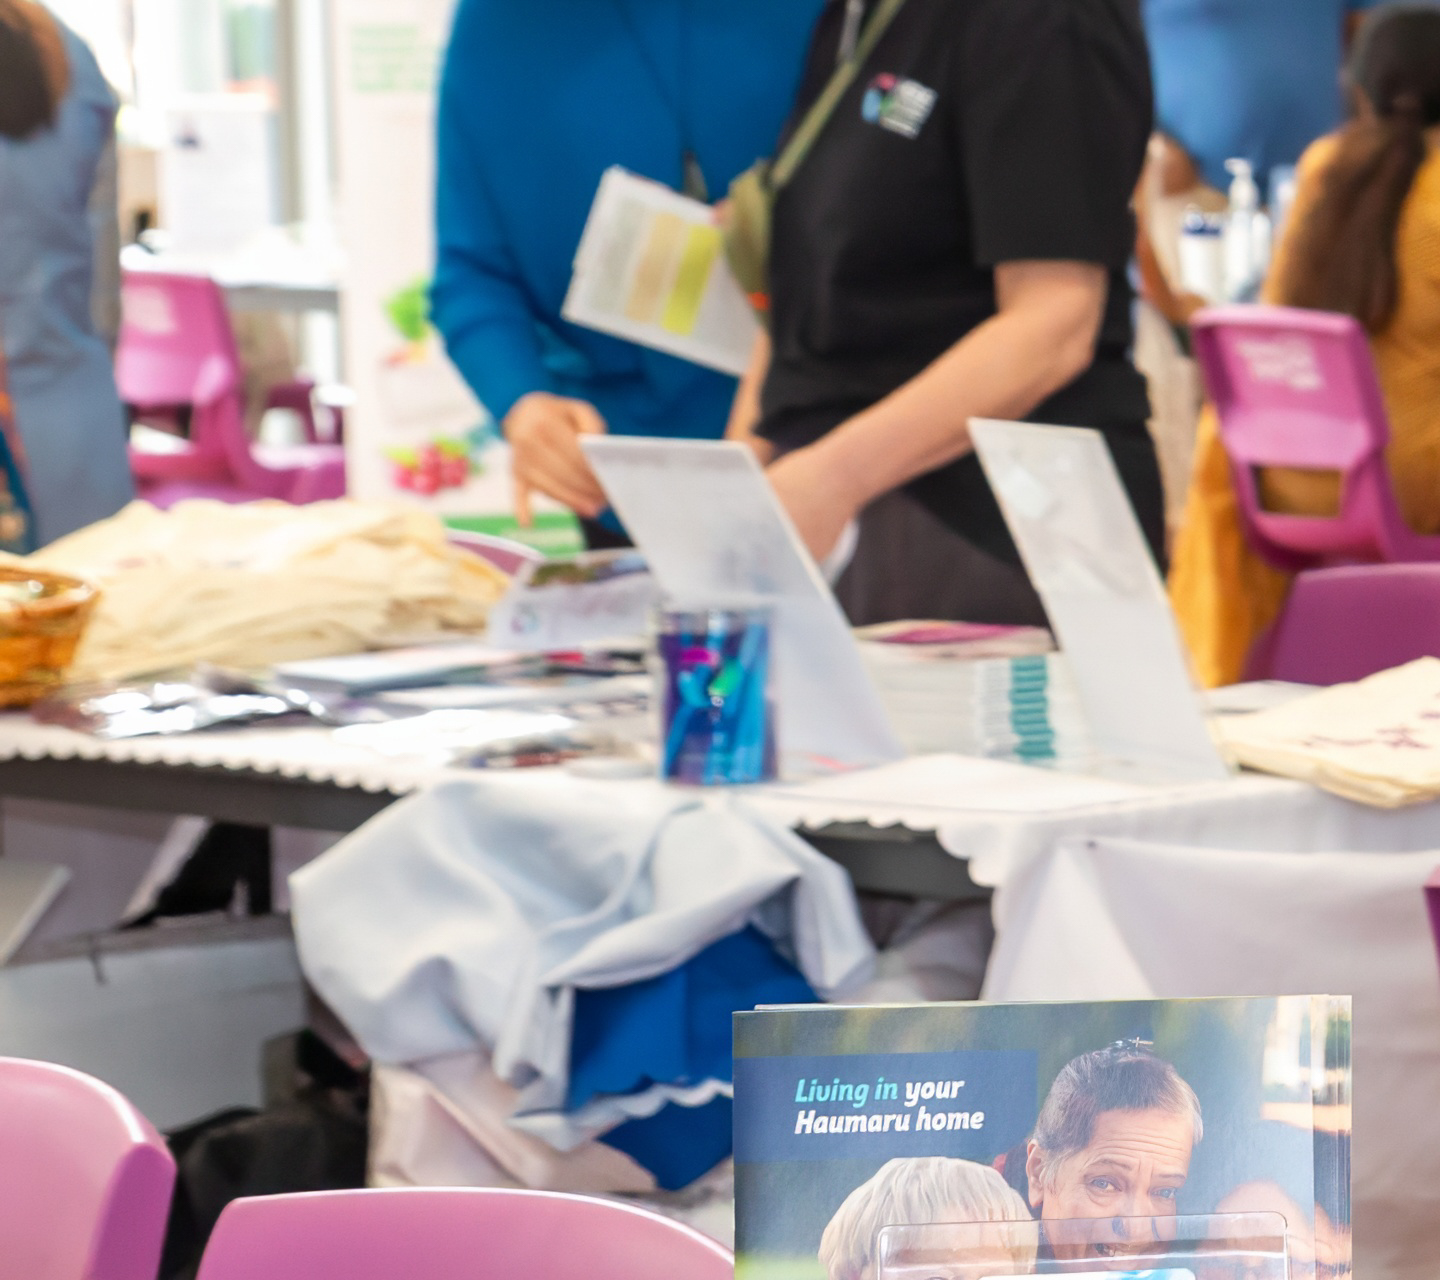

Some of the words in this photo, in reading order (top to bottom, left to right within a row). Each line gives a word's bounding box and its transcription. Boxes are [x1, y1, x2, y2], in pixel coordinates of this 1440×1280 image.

[794, 1076, 870, 1109] Living
[874, 1076, 898, 1101] in
[903, 1080, 966, 1108] your
[794, 1109, 910, 1135] Haumaru
[915, 1106, 985, 1132] home
